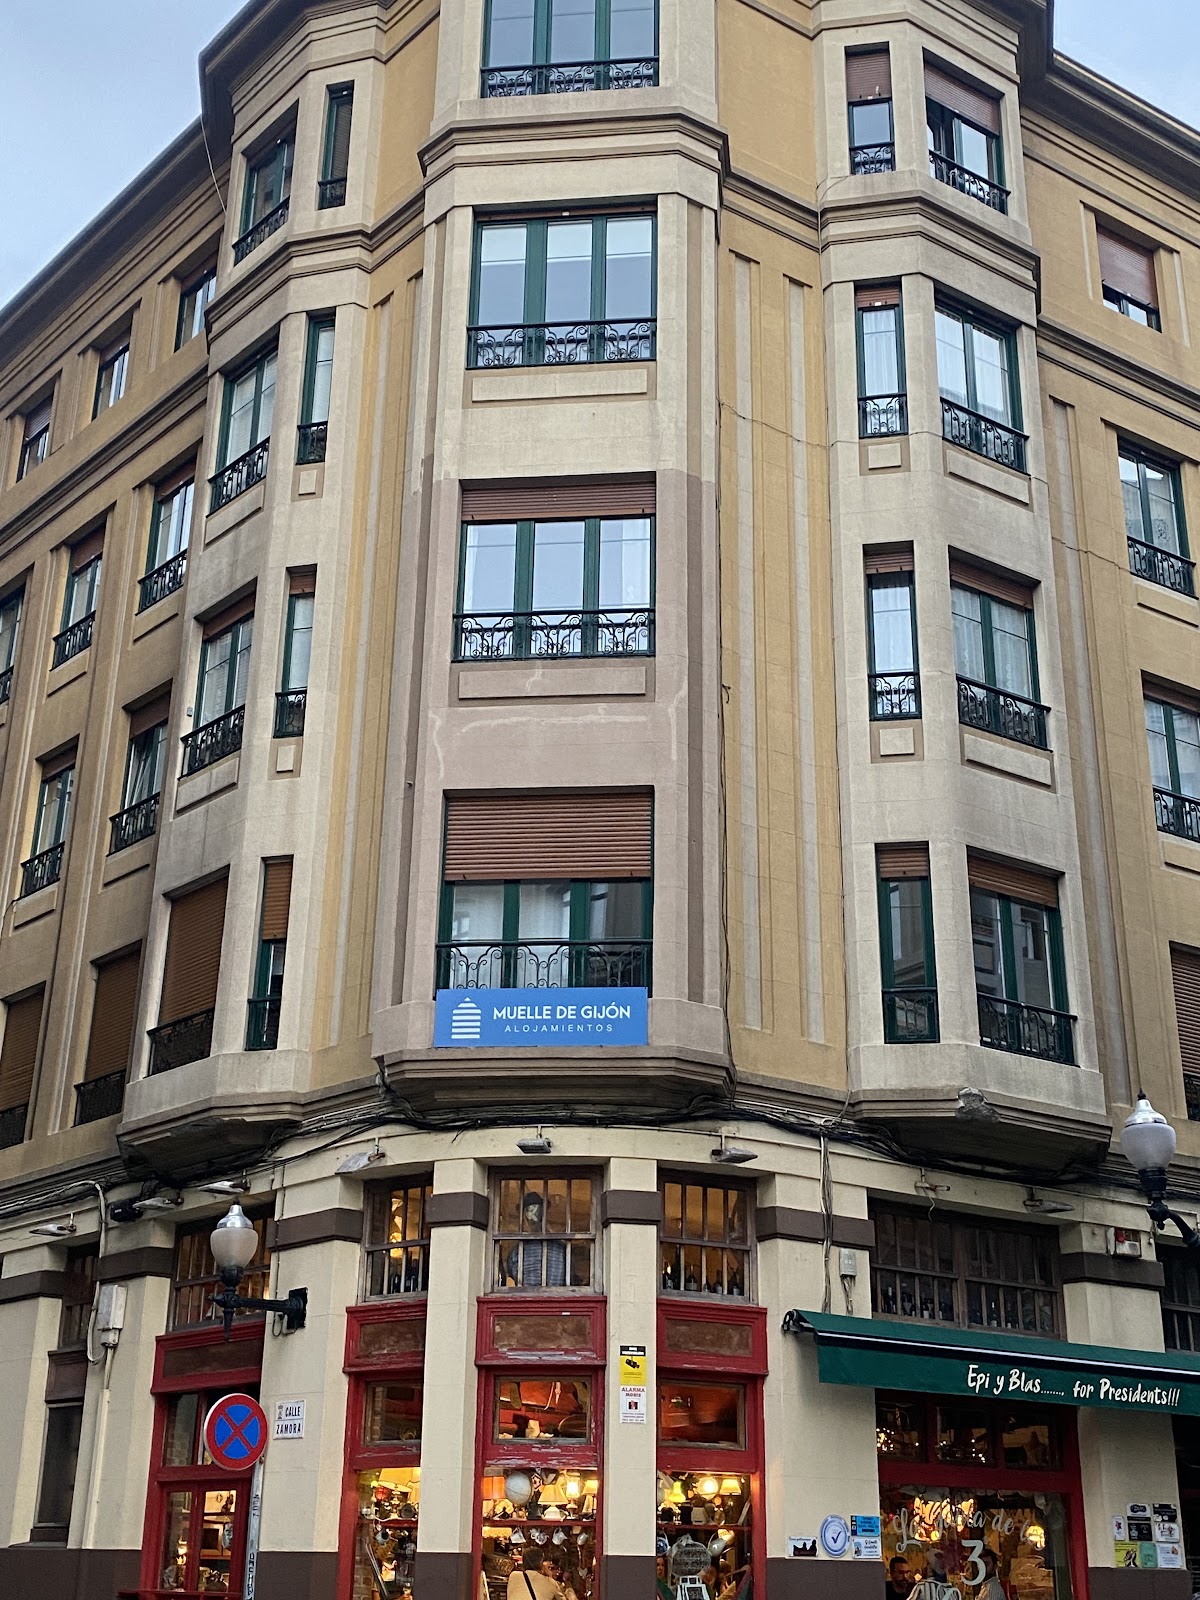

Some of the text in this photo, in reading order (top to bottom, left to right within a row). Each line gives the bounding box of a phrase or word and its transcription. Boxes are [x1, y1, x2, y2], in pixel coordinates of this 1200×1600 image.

[493, 1002, 631, 1019] MUELLE DE GIJÓN
[504, 1024, 613, 1033] ALOJAMIENTOS
[967, 1364, 991, 1394] Epi
[993, 1376, 1004, 1395] y
[1073, 1380, 1094, 1399] for
[1099, 1377, 1181, 1407] Presidents!!!
[285, 1406, 301, 1417] CALLE
[276, 1422, 301, 1434] ZAMORA
[960, 1539, 987, 1586] 3
